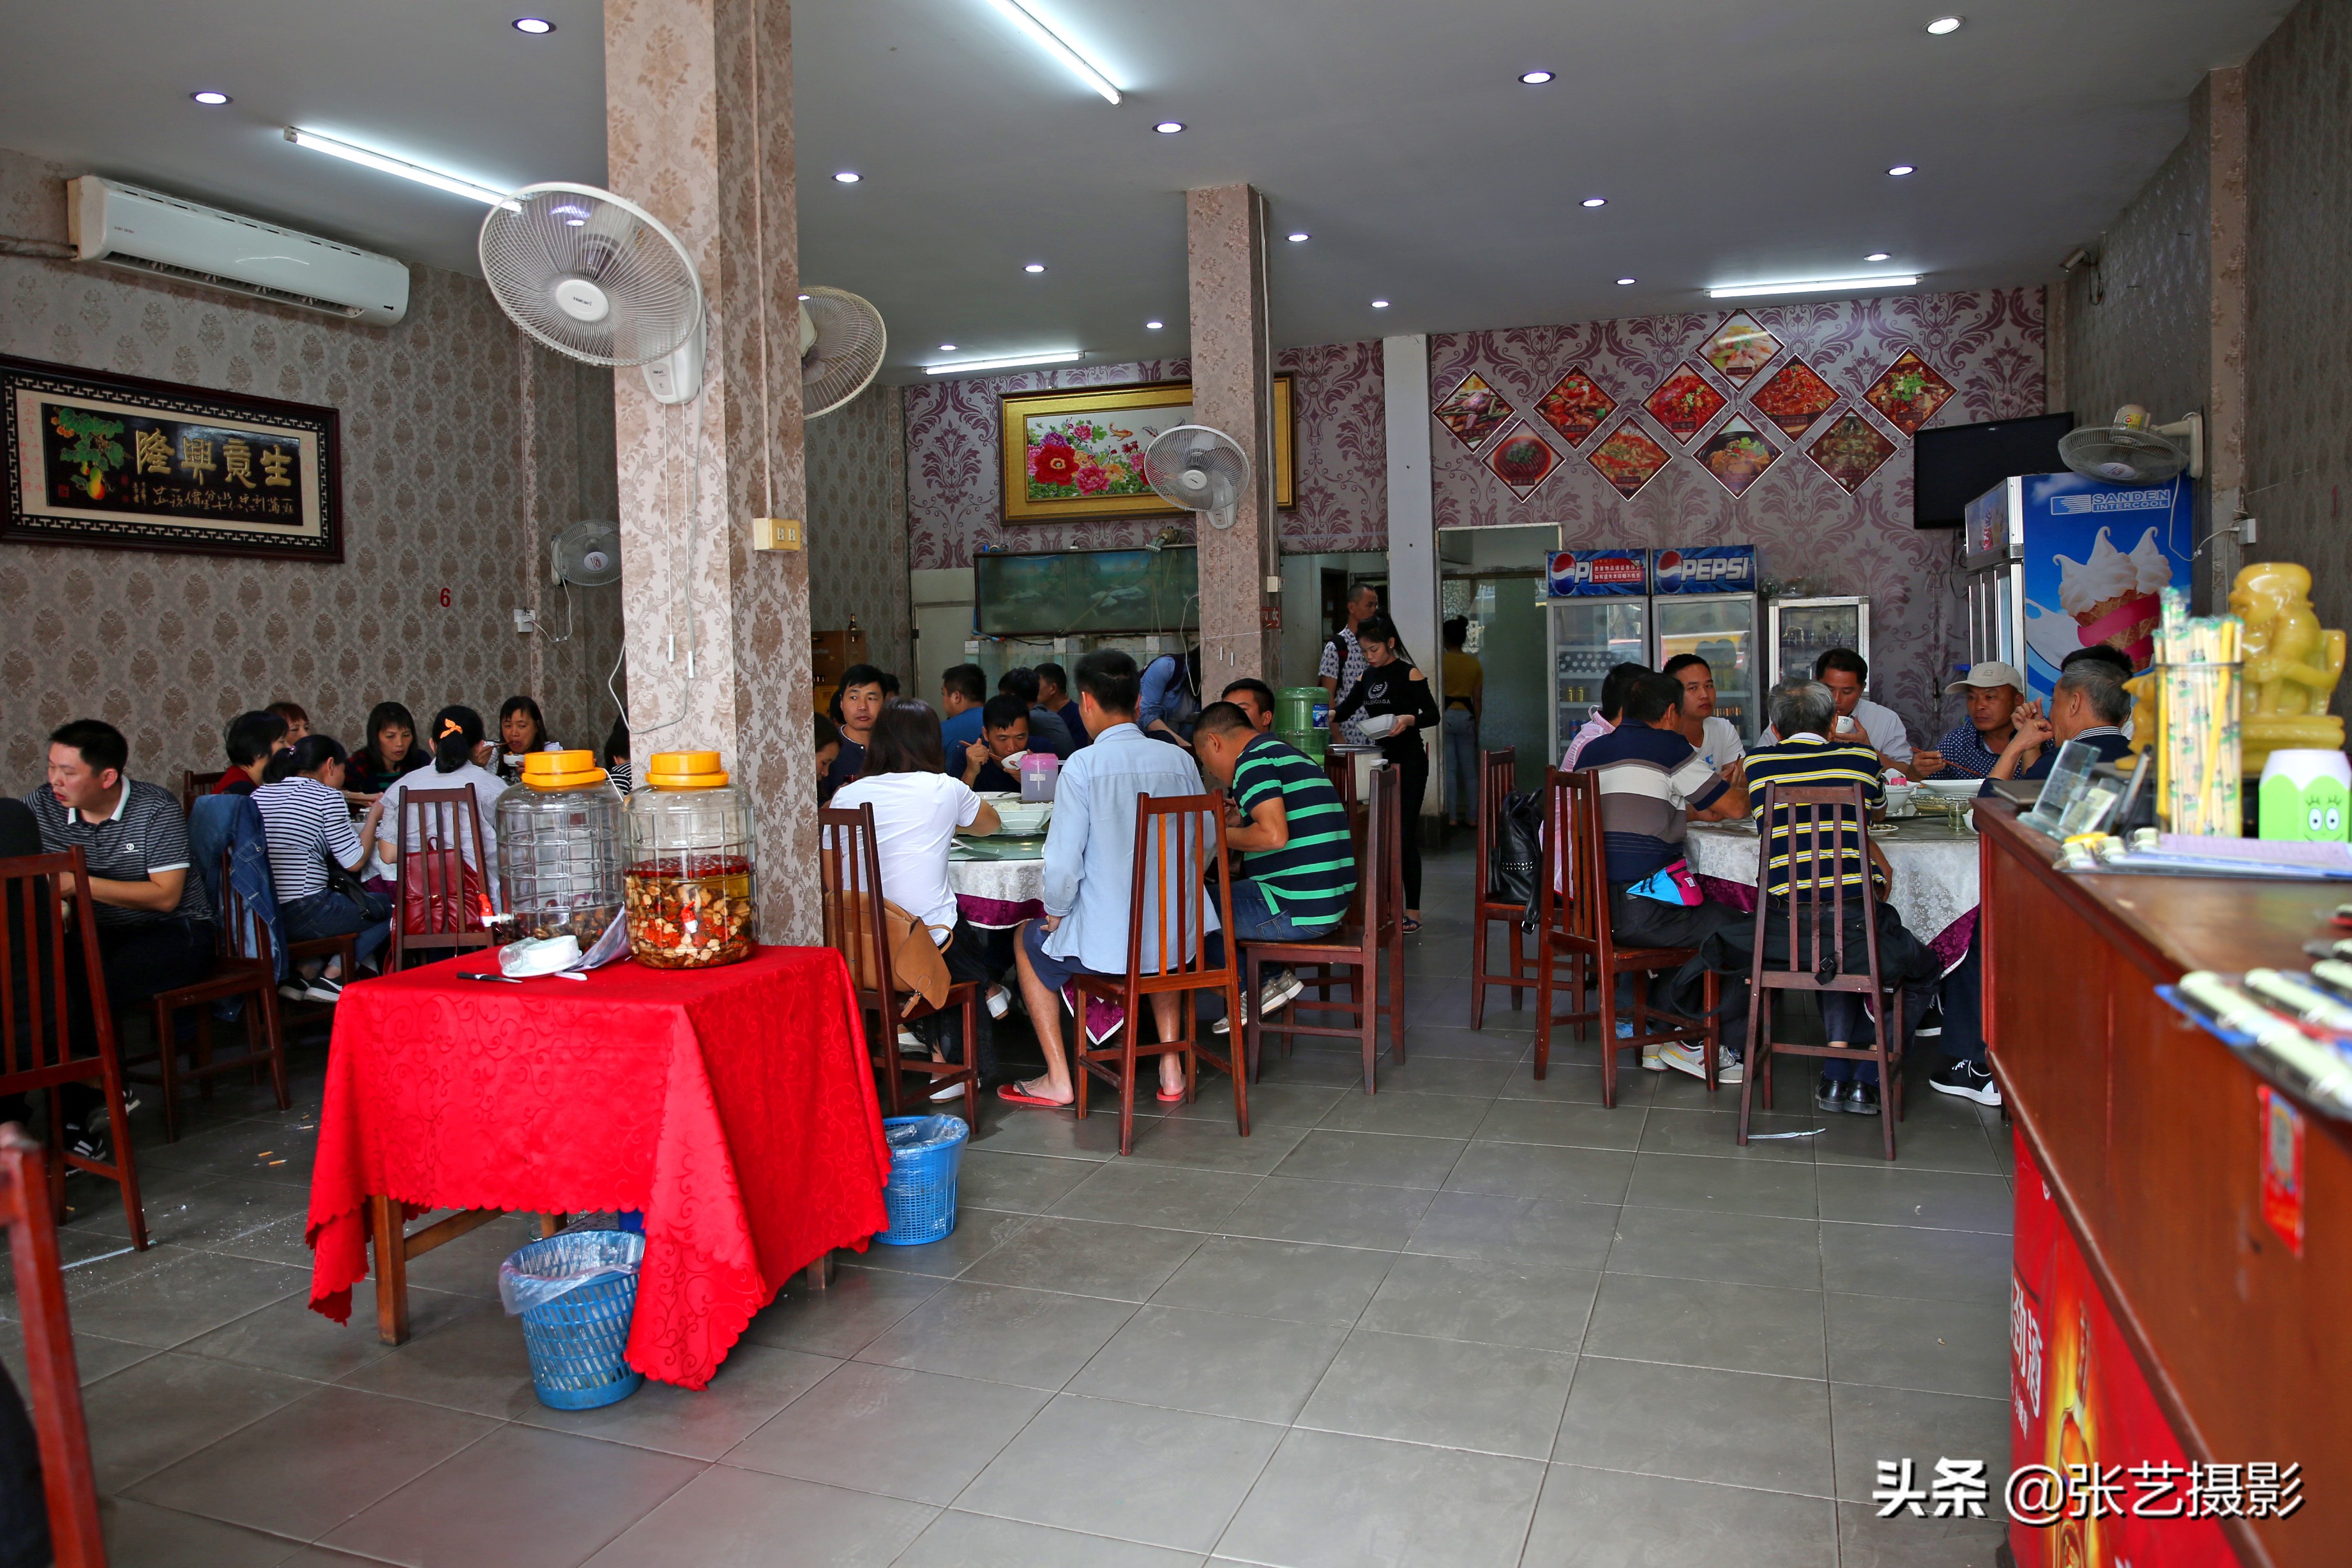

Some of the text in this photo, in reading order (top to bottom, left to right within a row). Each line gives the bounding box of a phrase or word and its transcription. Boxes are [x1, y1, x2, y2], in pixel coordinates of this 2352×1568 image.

[2092, 490, 2170, 504] SANDEN
[2096, 501, 2166, 510] INTERCOOL
[1680, 557, 1750, 581] PEPSI
[441, 587, 451, 608] 6
[2011, 1277, 2042, 1418] 劲酒
